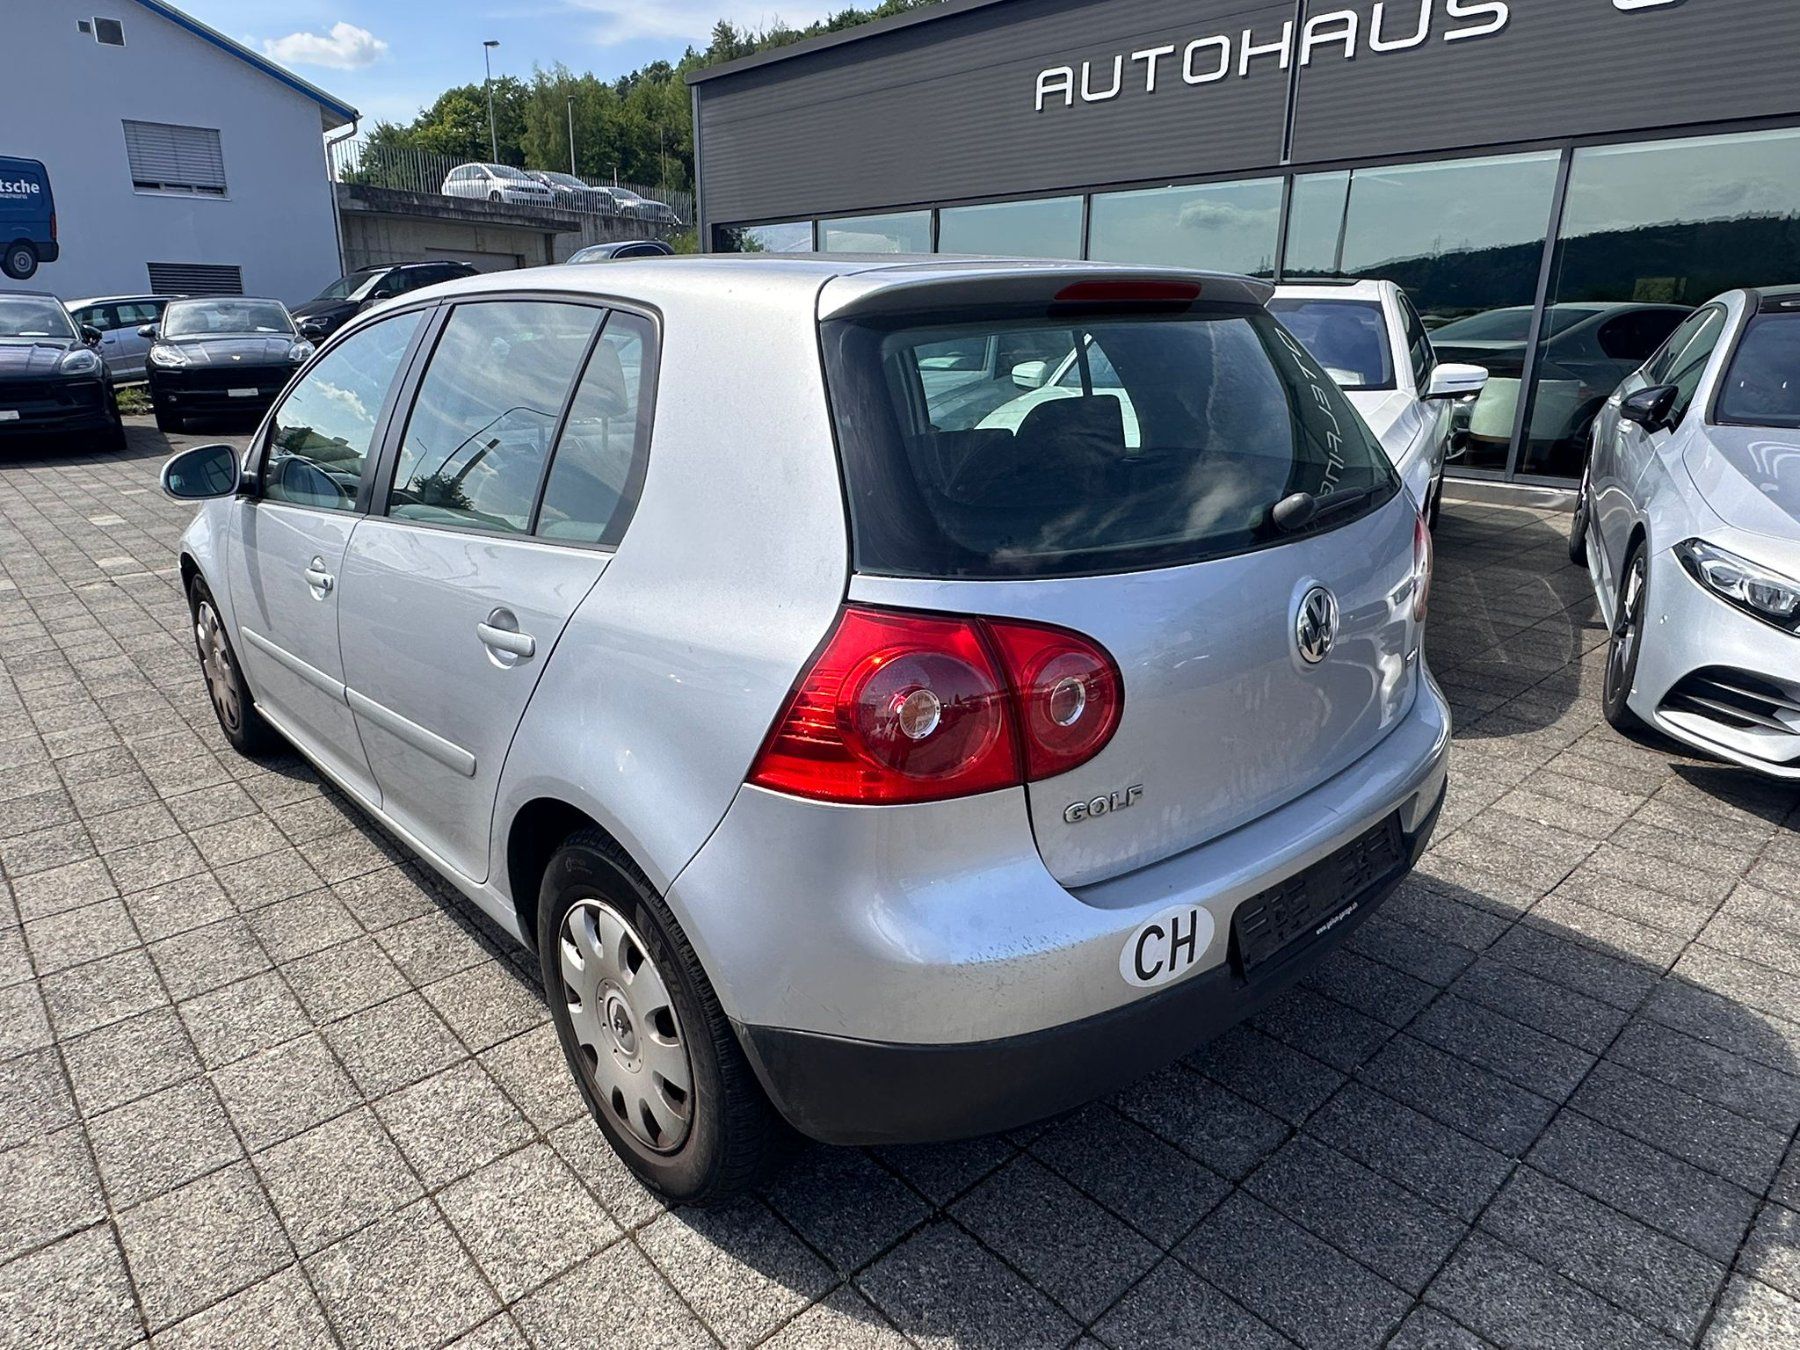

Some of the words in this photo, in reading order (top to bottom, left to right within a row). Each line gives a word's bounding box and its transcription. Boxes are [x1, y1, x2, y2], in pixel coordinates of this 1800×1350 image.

[1034, 0, 1509, 112] AUTOHAUS
[1297, 588, 1338, 663] VW
[1063, 784, 1144, 824] GOLF
[1134, 909, 1198, 981] CH
